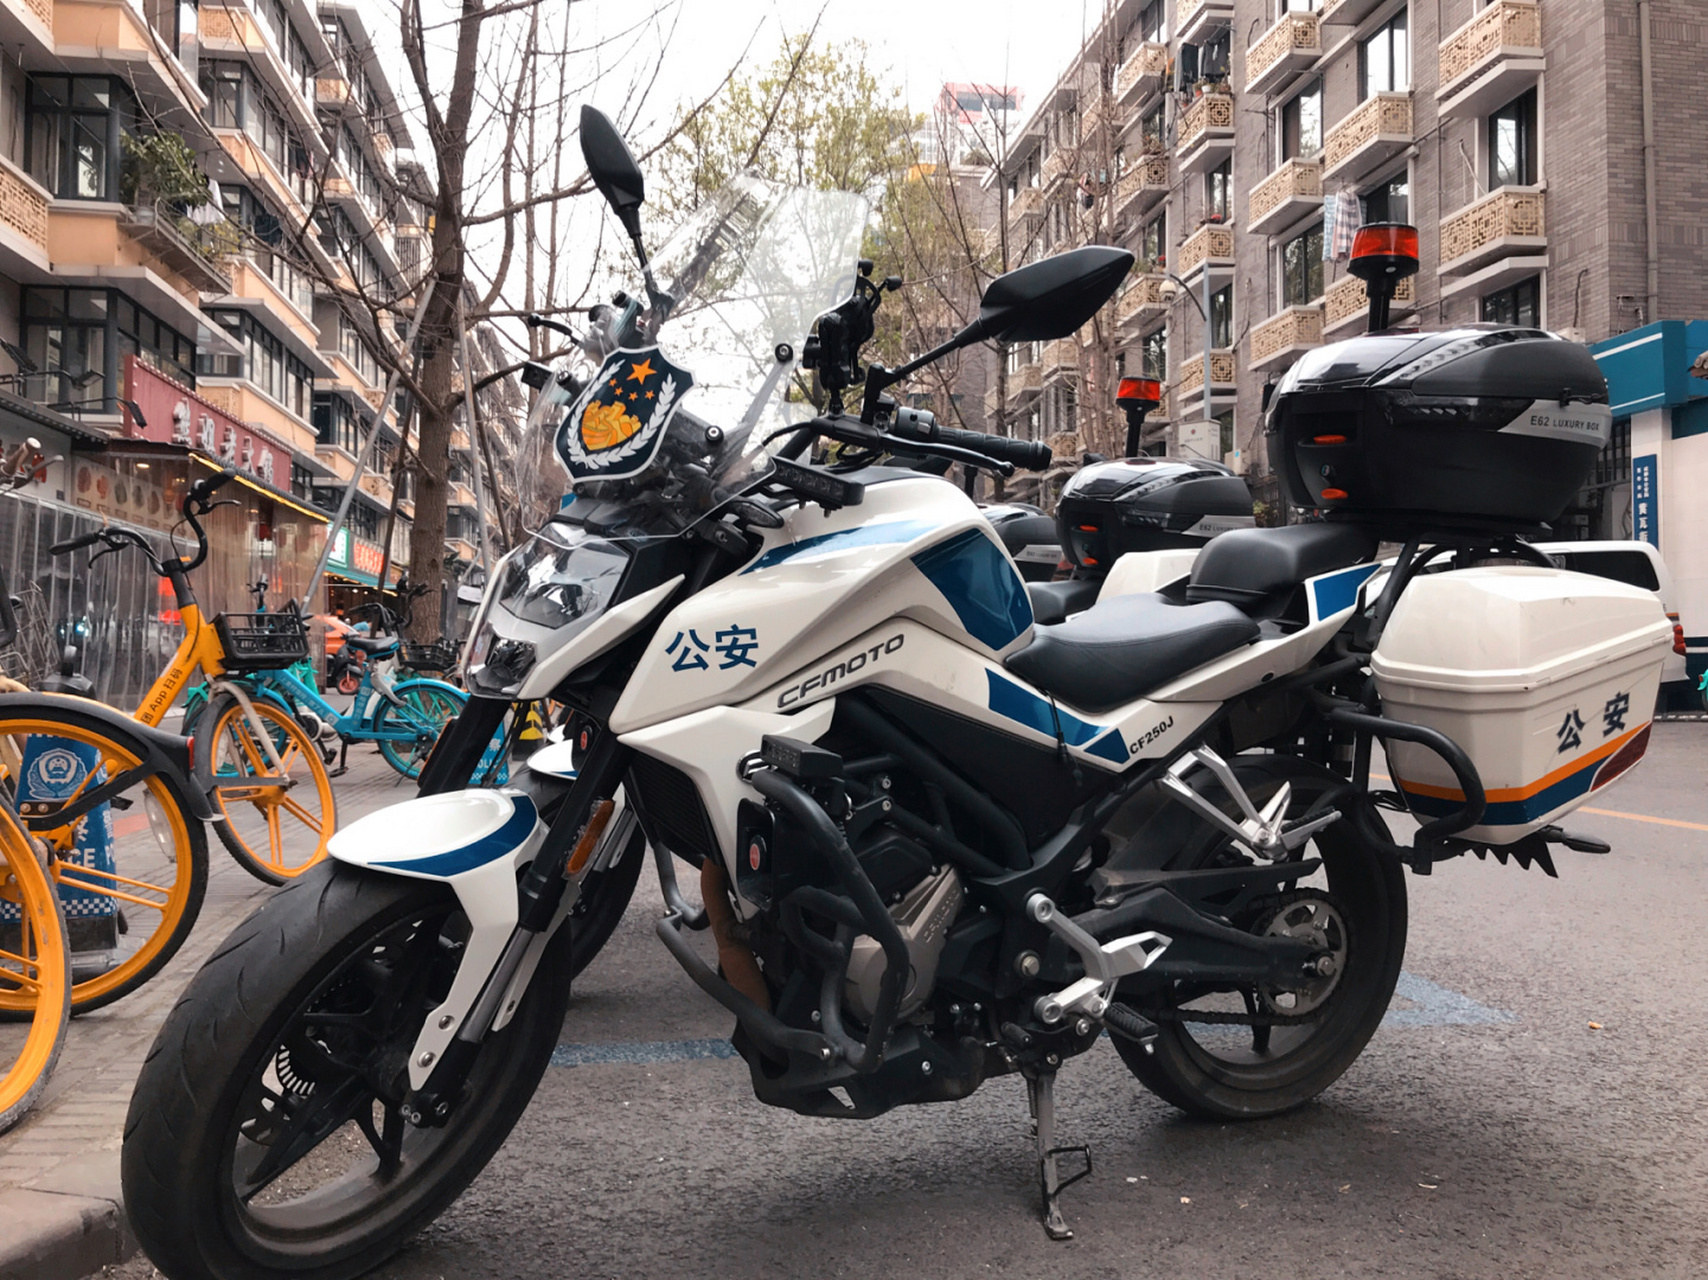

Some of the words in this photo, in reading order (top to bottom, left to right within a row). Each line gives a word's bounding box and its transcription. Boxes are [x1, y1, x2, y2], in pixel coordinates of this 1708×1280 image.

[1530, 415, 1550, 427] E62
[1553, 418, 1585, 430] LUXURY
[1586, 421, 1600, 431] BOX
[665, 624, 759, 673] 公安
[777, 634, 905, 709] CFMOTO
[149, 690, 167, 712] App
[163, 667, 183, 690] 扫码
[1129, 715, 1174, 755] CF250J
[1556, 690, 1630, 755] 公安
